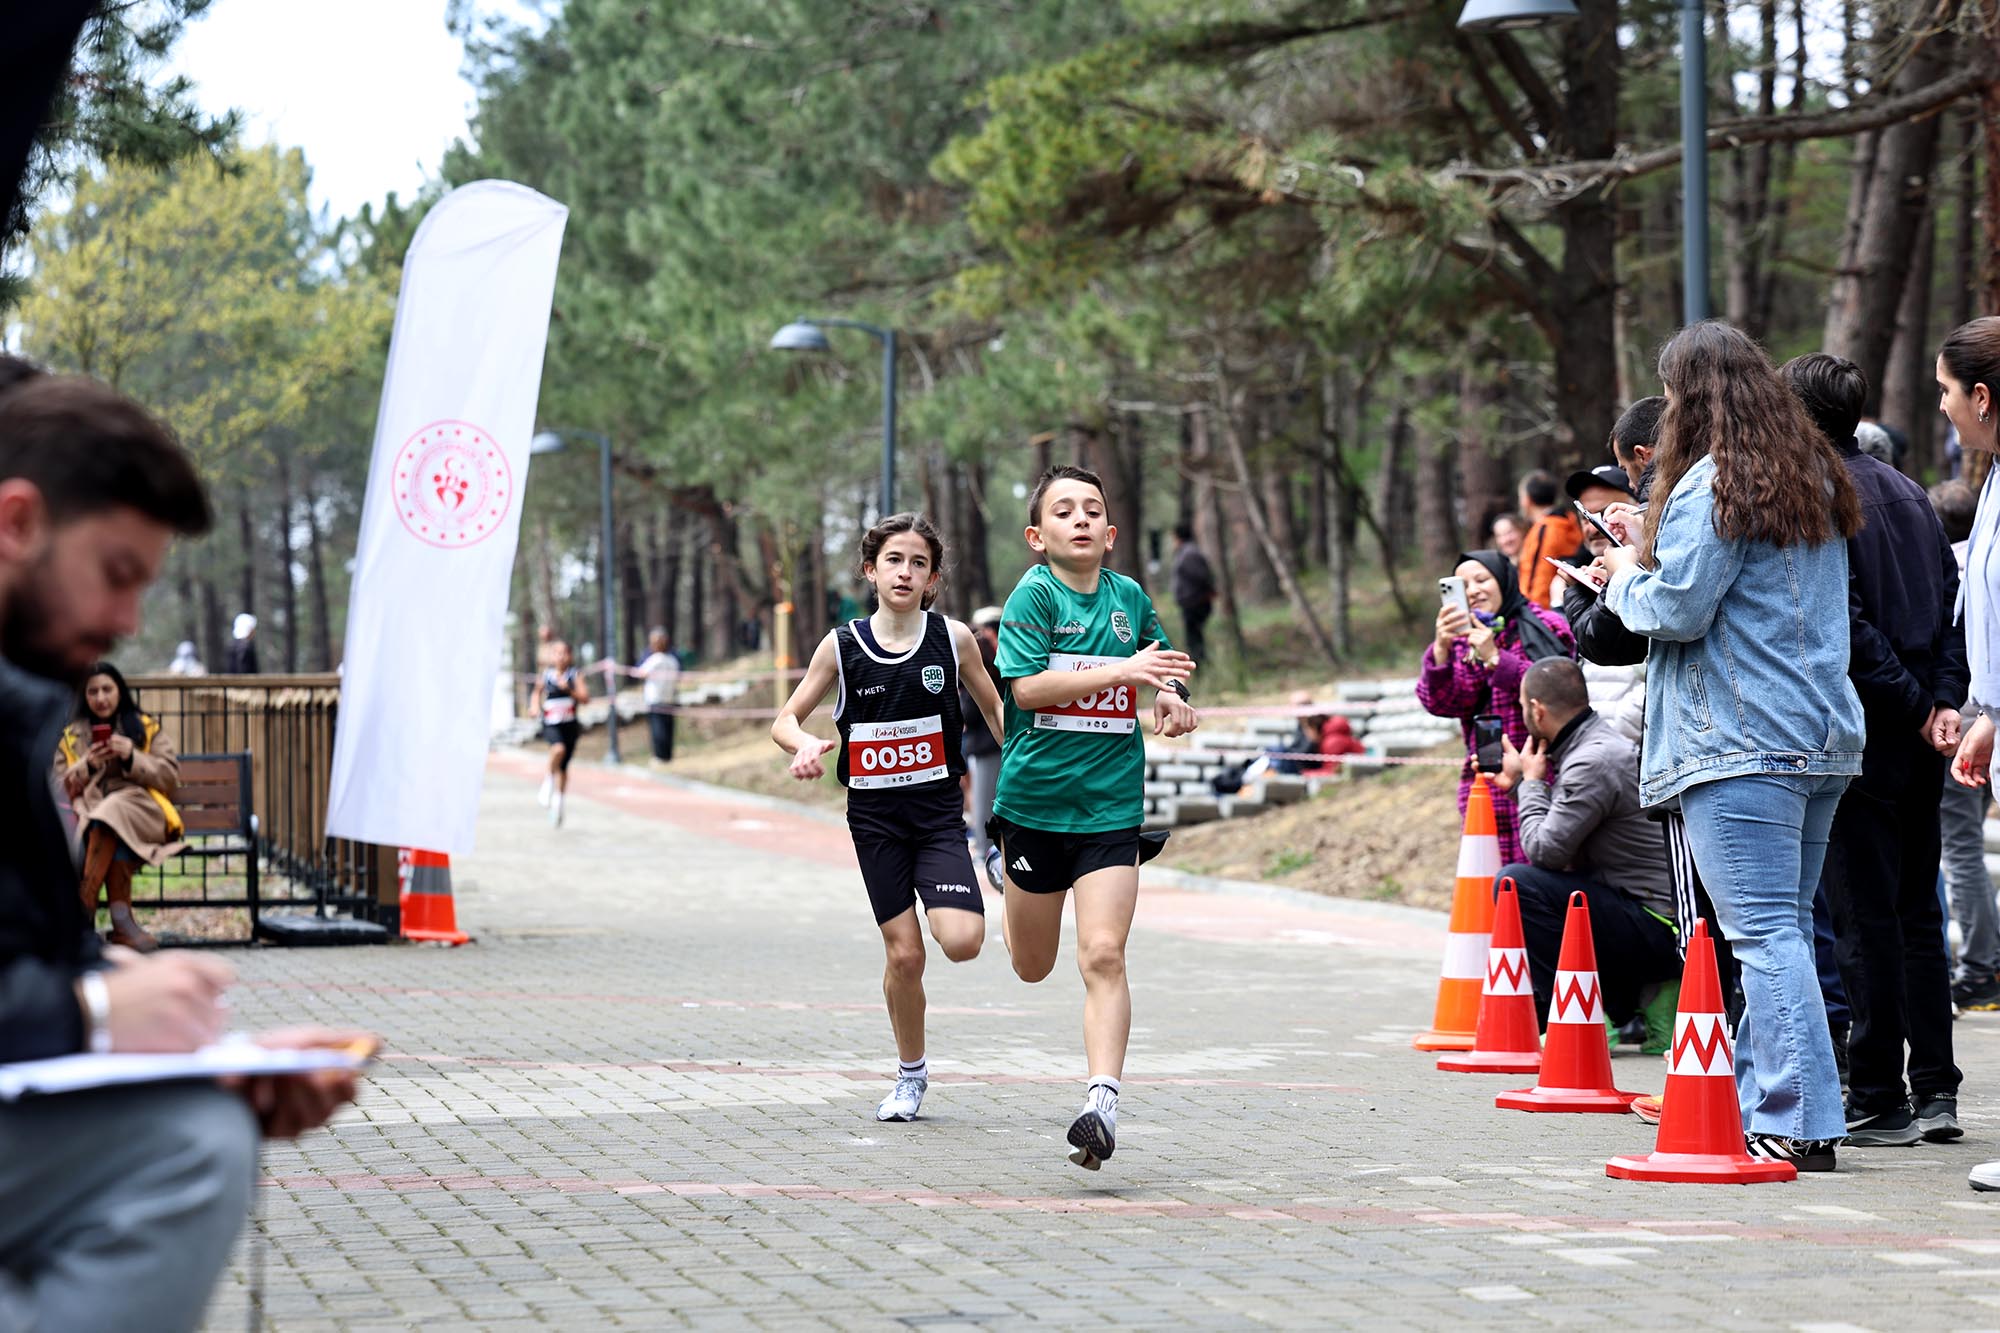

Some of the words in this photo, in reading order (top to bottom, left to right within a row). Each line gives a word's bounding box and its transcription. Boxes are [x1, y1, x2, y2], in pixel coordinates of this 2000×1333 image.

[924, 669, 943, 681] SBB
[1055, 685, 1129, 712] 026
[861, 741, 933, 770] 0058
